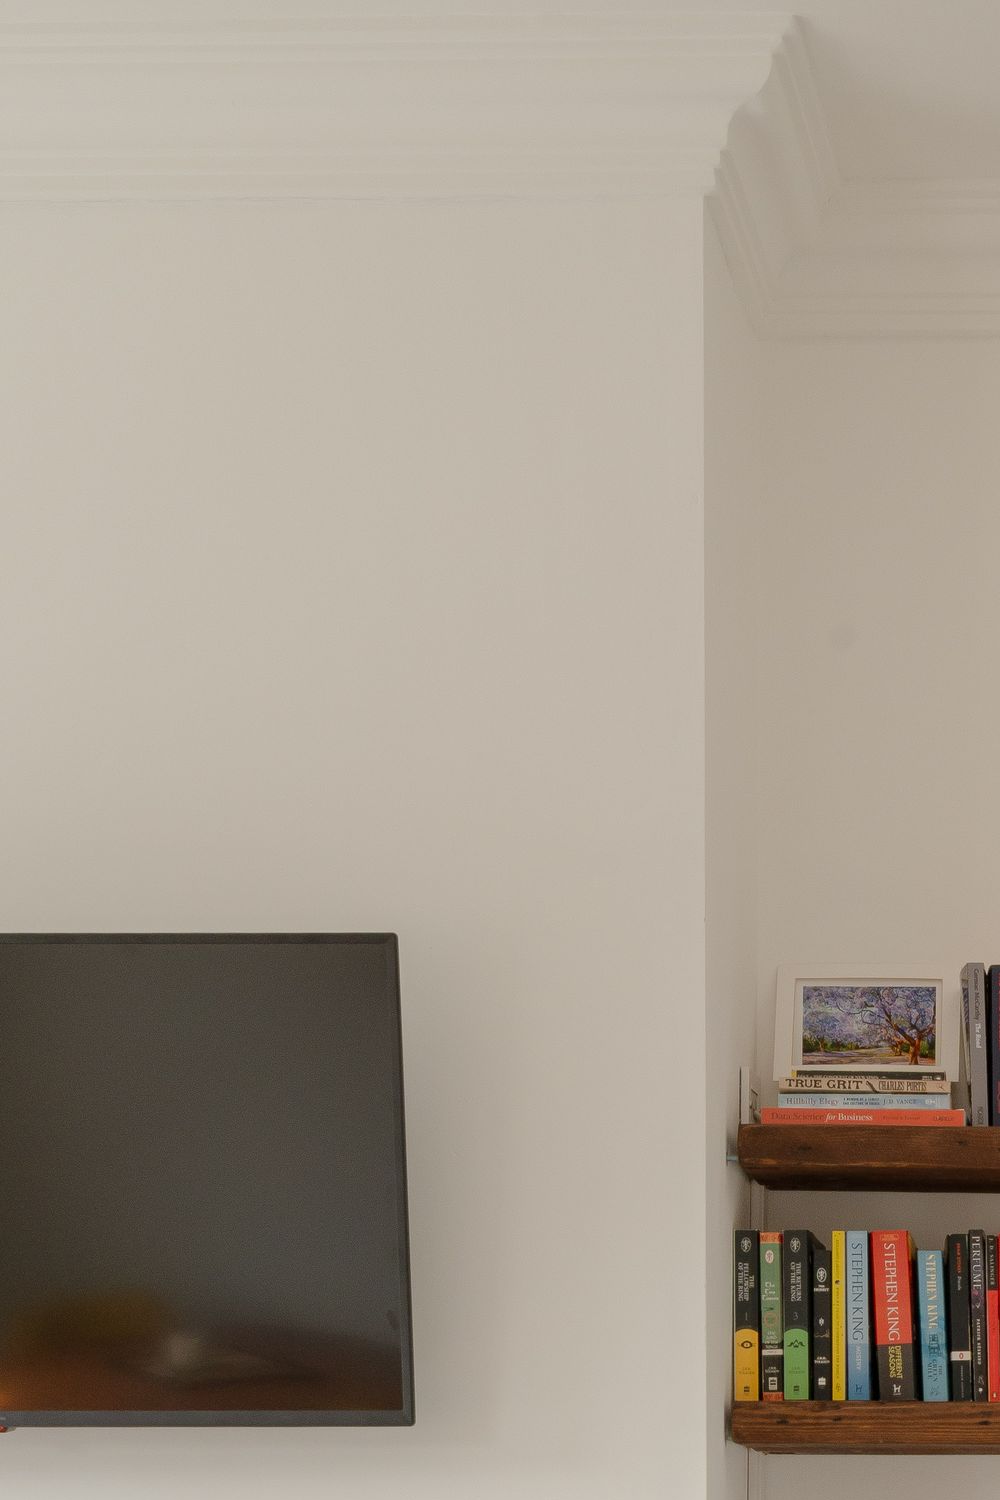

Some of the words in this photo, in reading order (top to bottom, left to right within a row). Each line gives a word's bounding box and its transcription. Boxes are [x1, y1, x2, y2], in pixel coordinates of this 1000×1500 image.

[785, 1079, 821, 1089] TRUE
[827, 1079, 862, 1089] GRIT
[879, 1081, 904, 1091] CHARLES
[907, 1082, 927, 1091] PORTIS
[771, 1112, 791, 1120] Data
[793, 1112, 825, 1120] Science
[825, 1113, 837, 1122] for
[838, 1113, 873, 1121] Business
[786, 1097, 816, 1106] Hillbilly
[819, 1097, 839, 1106] Elegy
[738, 1262, 744, 1270] OF
[790, 1262, 796, 1272] OF
[851, 1243, 862, 1303] STEPHEN
[883, 1243, 898, 1302] STEPHEN
[926, 1254, 937, 1300] STEPHEN
[971, 1236, 981, 1290] PERFUME
[852, 1307, 863, 1340] KING
[887, 1306, 900, 1341] KING
[927, 1304, 938, 1329] KING
[888, 1346, 897, 1378] SEASONS
[895, 1345, 903, 1379] DIFFERENT
